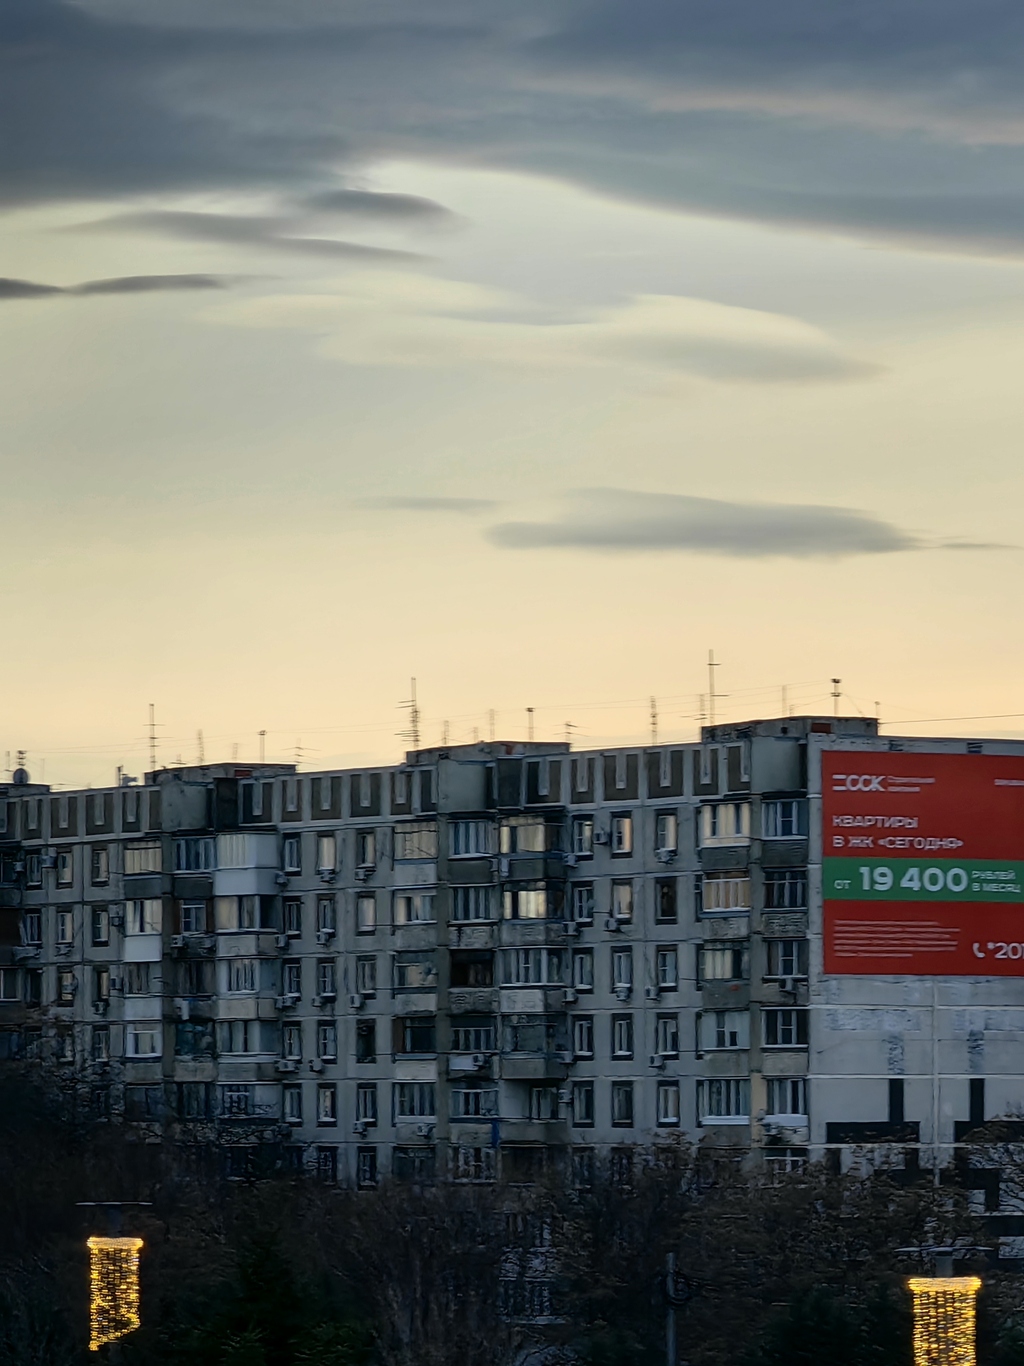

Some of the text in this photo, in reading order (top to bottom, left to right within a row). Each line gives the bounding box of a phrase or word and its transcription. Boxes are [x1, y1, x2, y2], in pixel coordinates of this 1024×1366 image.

[833, 816, 918, 828] КВАРТИРЫ
[833, 836, 963, 850] В ЖК «СЕГОДНЯ»
[859, 867, 893, 891] 19
[900, 868, 968, 892] 400
